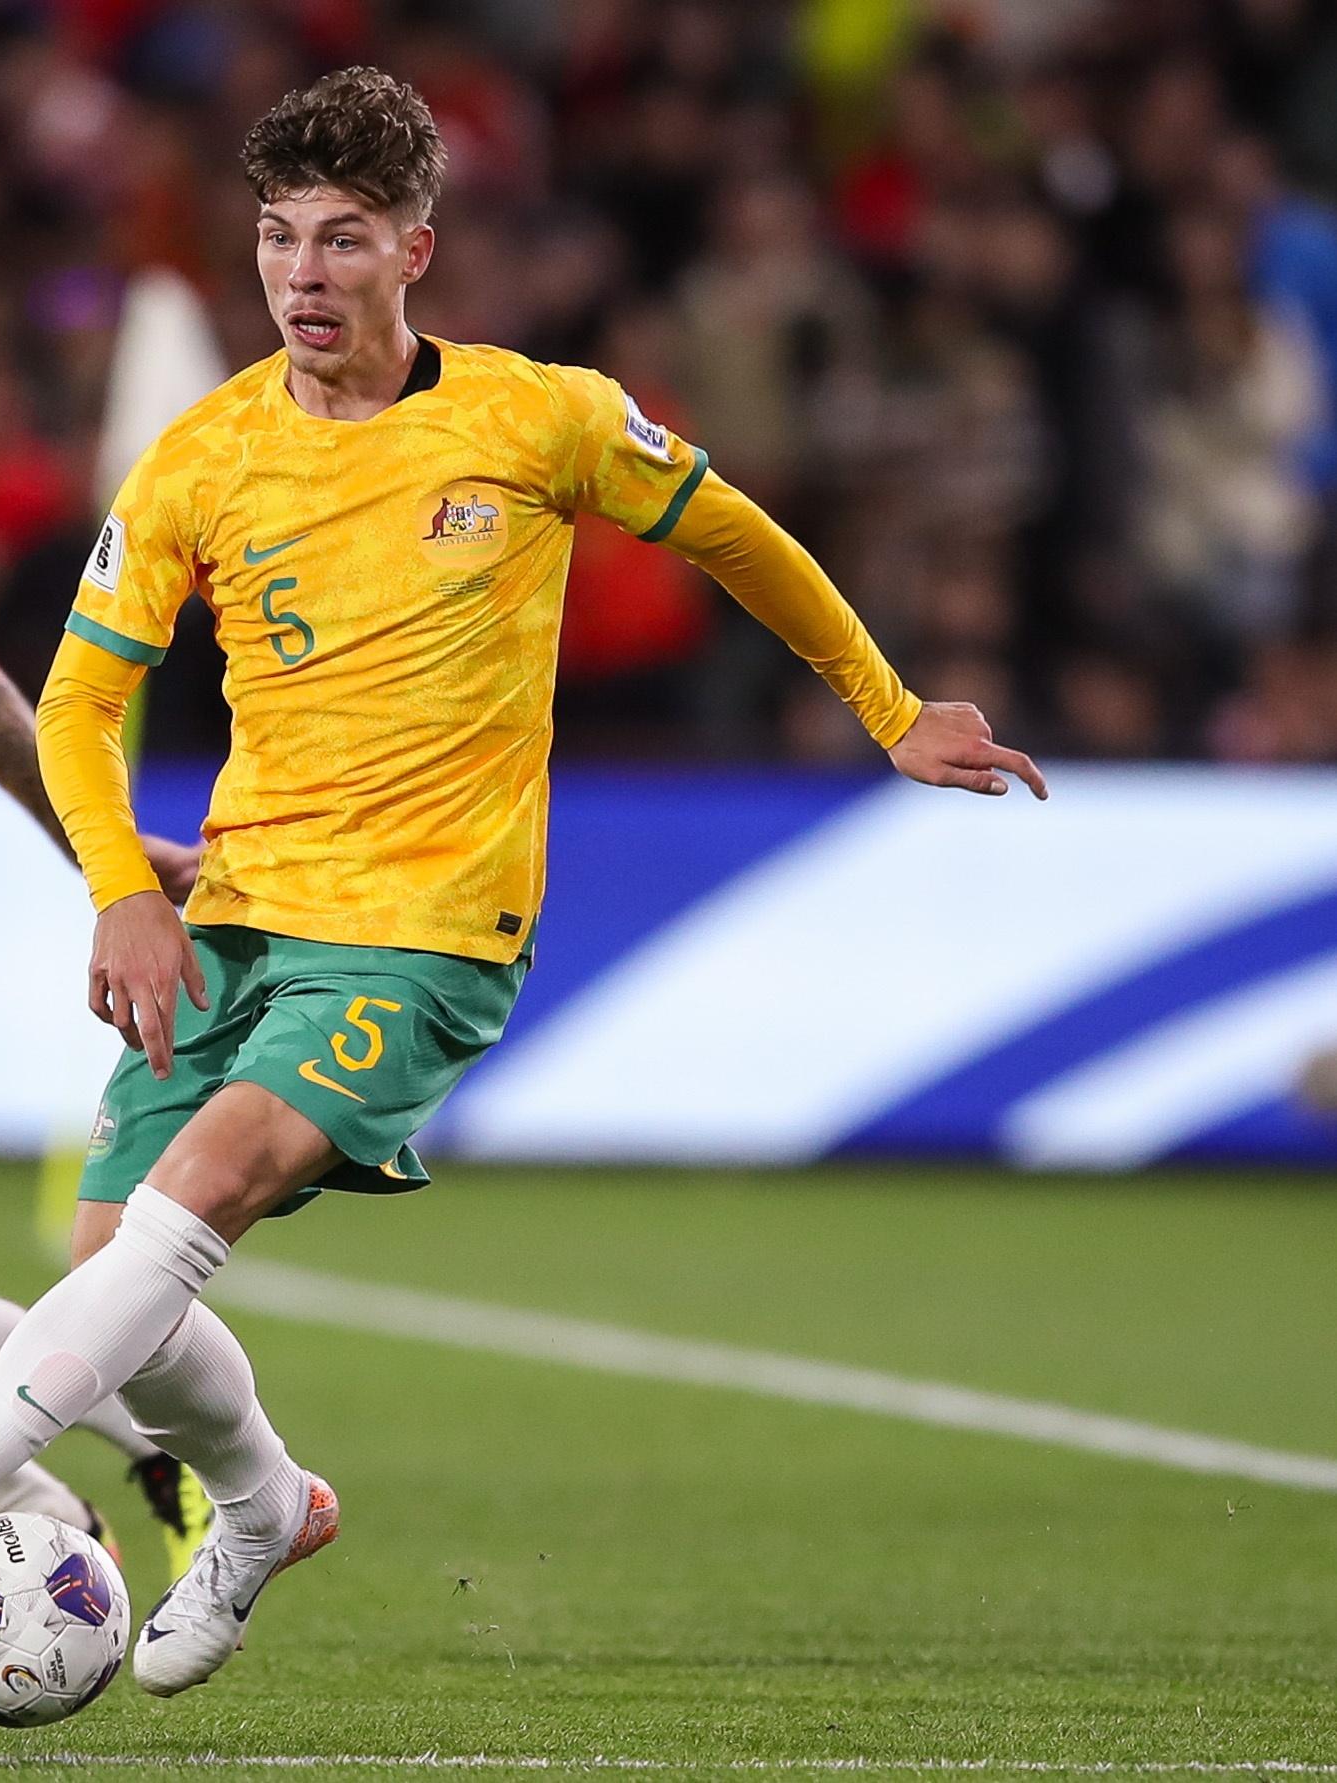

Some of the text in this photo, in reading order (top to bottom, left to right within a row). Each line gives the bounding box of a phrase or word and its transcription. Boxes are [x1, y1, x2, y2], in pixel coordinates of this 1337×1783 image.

[435, 533, 493, 547] AUSTRALIA
[263, 576, 313, 665] 5
[330, 996, 402, 1072] 5
